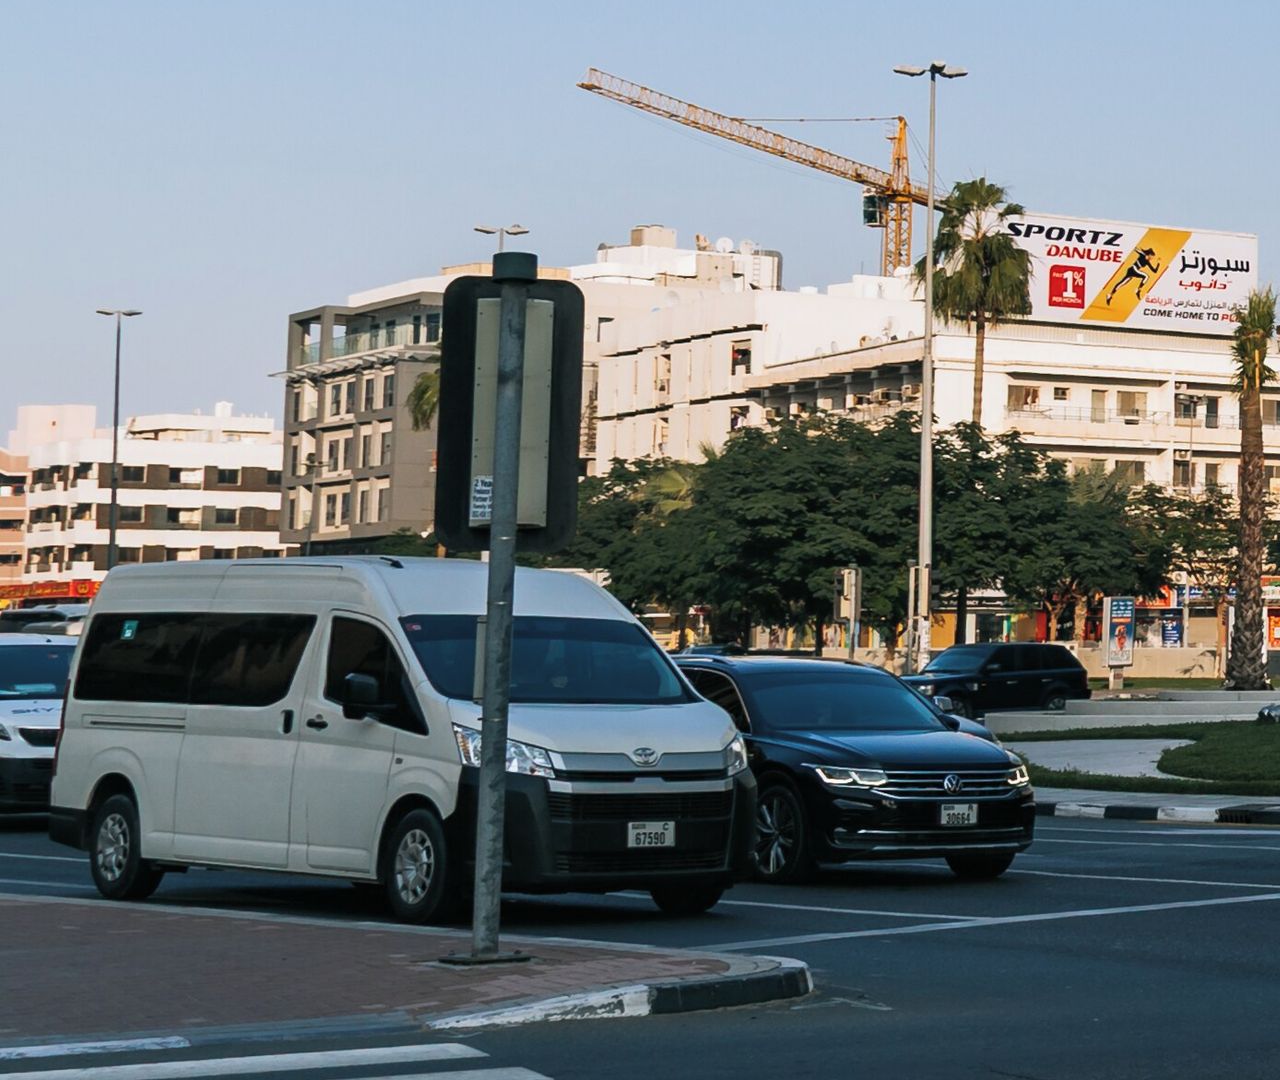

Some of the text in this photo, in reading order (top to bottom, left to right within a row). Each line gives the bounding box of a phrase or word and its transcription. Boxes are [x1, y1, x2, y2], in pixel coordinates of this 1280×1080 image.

[1005, 222, 1124, 247] SPORTZ
[1046, 244, 1124, 263] DANUBE
[1179, 249, 1250, 277] سبورتز
[1062, 270, 1085, 298] 1%
[1178, 279, 1228, 292] دانوب
[1143, 308, 1173, 318] COME
[1175, 310, 1205, 321] HOME
[1206, 312, 1219, 321] TO
[662, 822, 670, 831] C
[635, 831, 666, 845] 67590
